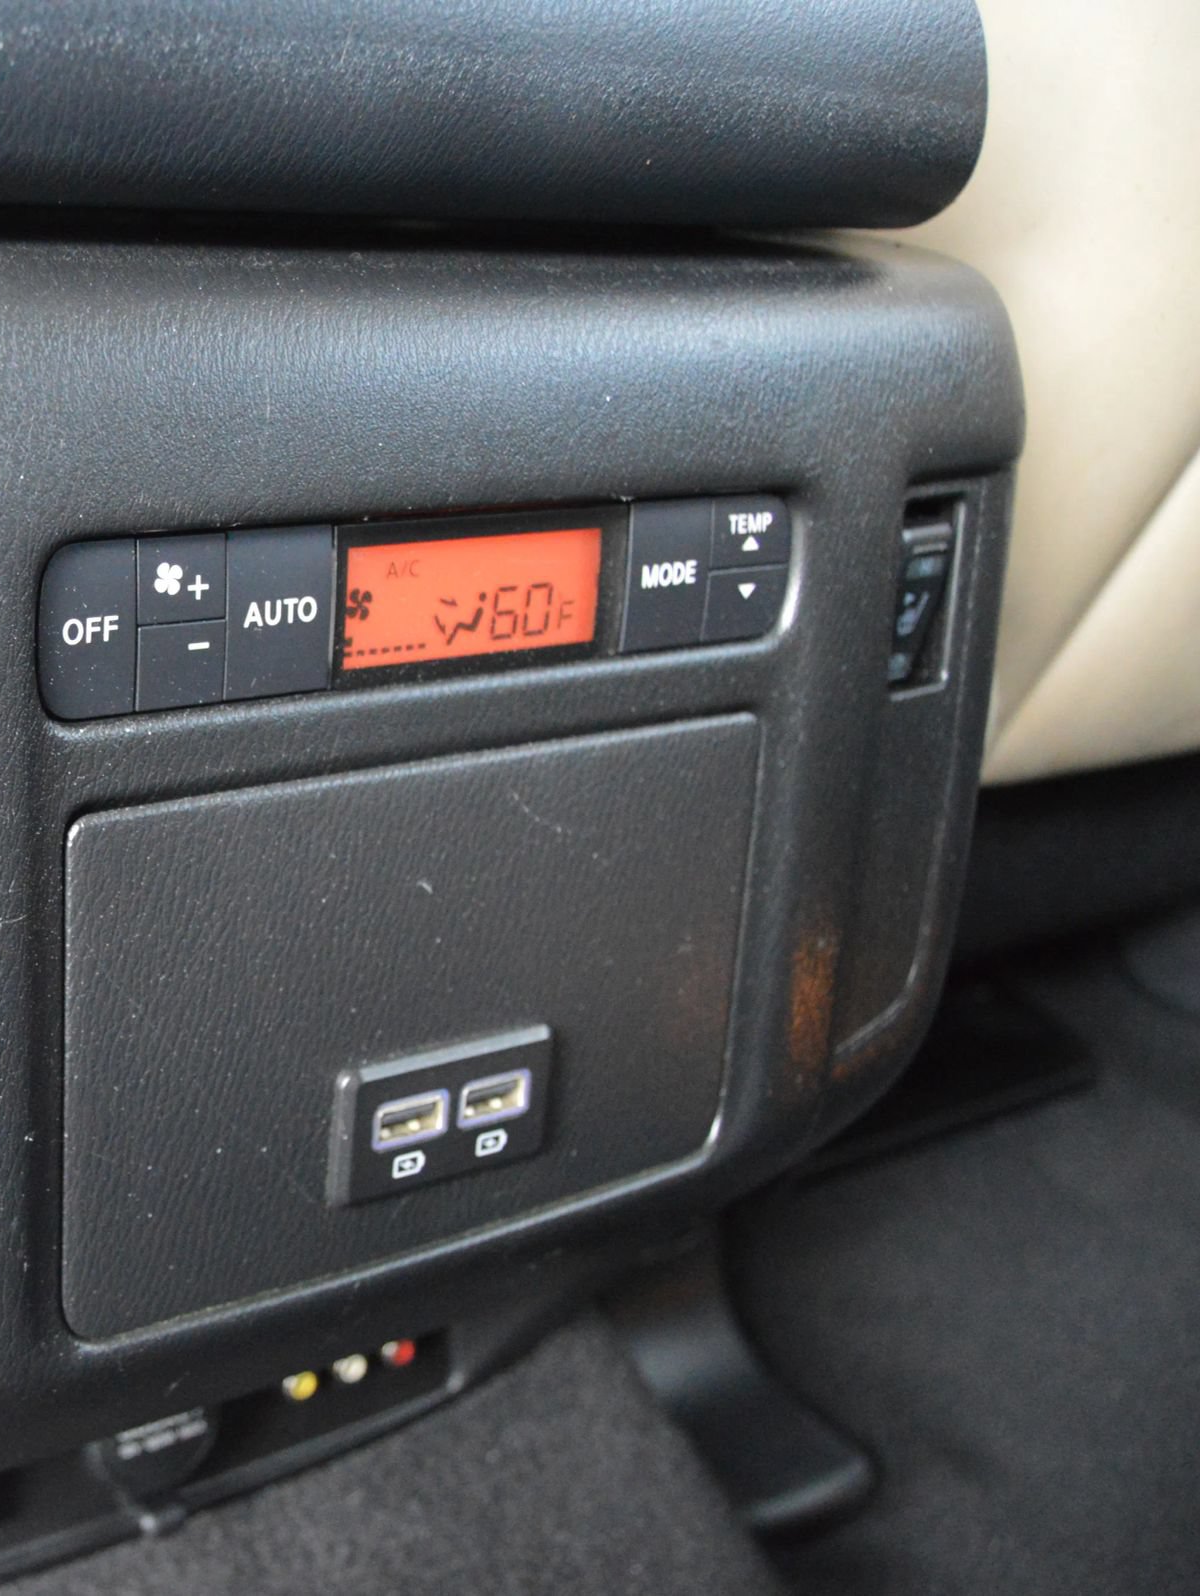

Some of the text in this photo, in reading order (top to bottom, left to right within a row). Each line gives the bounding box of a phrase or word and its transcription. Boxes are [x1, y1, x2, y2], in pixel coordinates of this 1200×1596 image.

[728, 511, 773, 535] TEMP
[386, 559, 420, 579] A/C
[641, 559, 698, 589] MODE
[243, 596, 317, 628] AUTO
[62, 615, 119, 645] OFF
